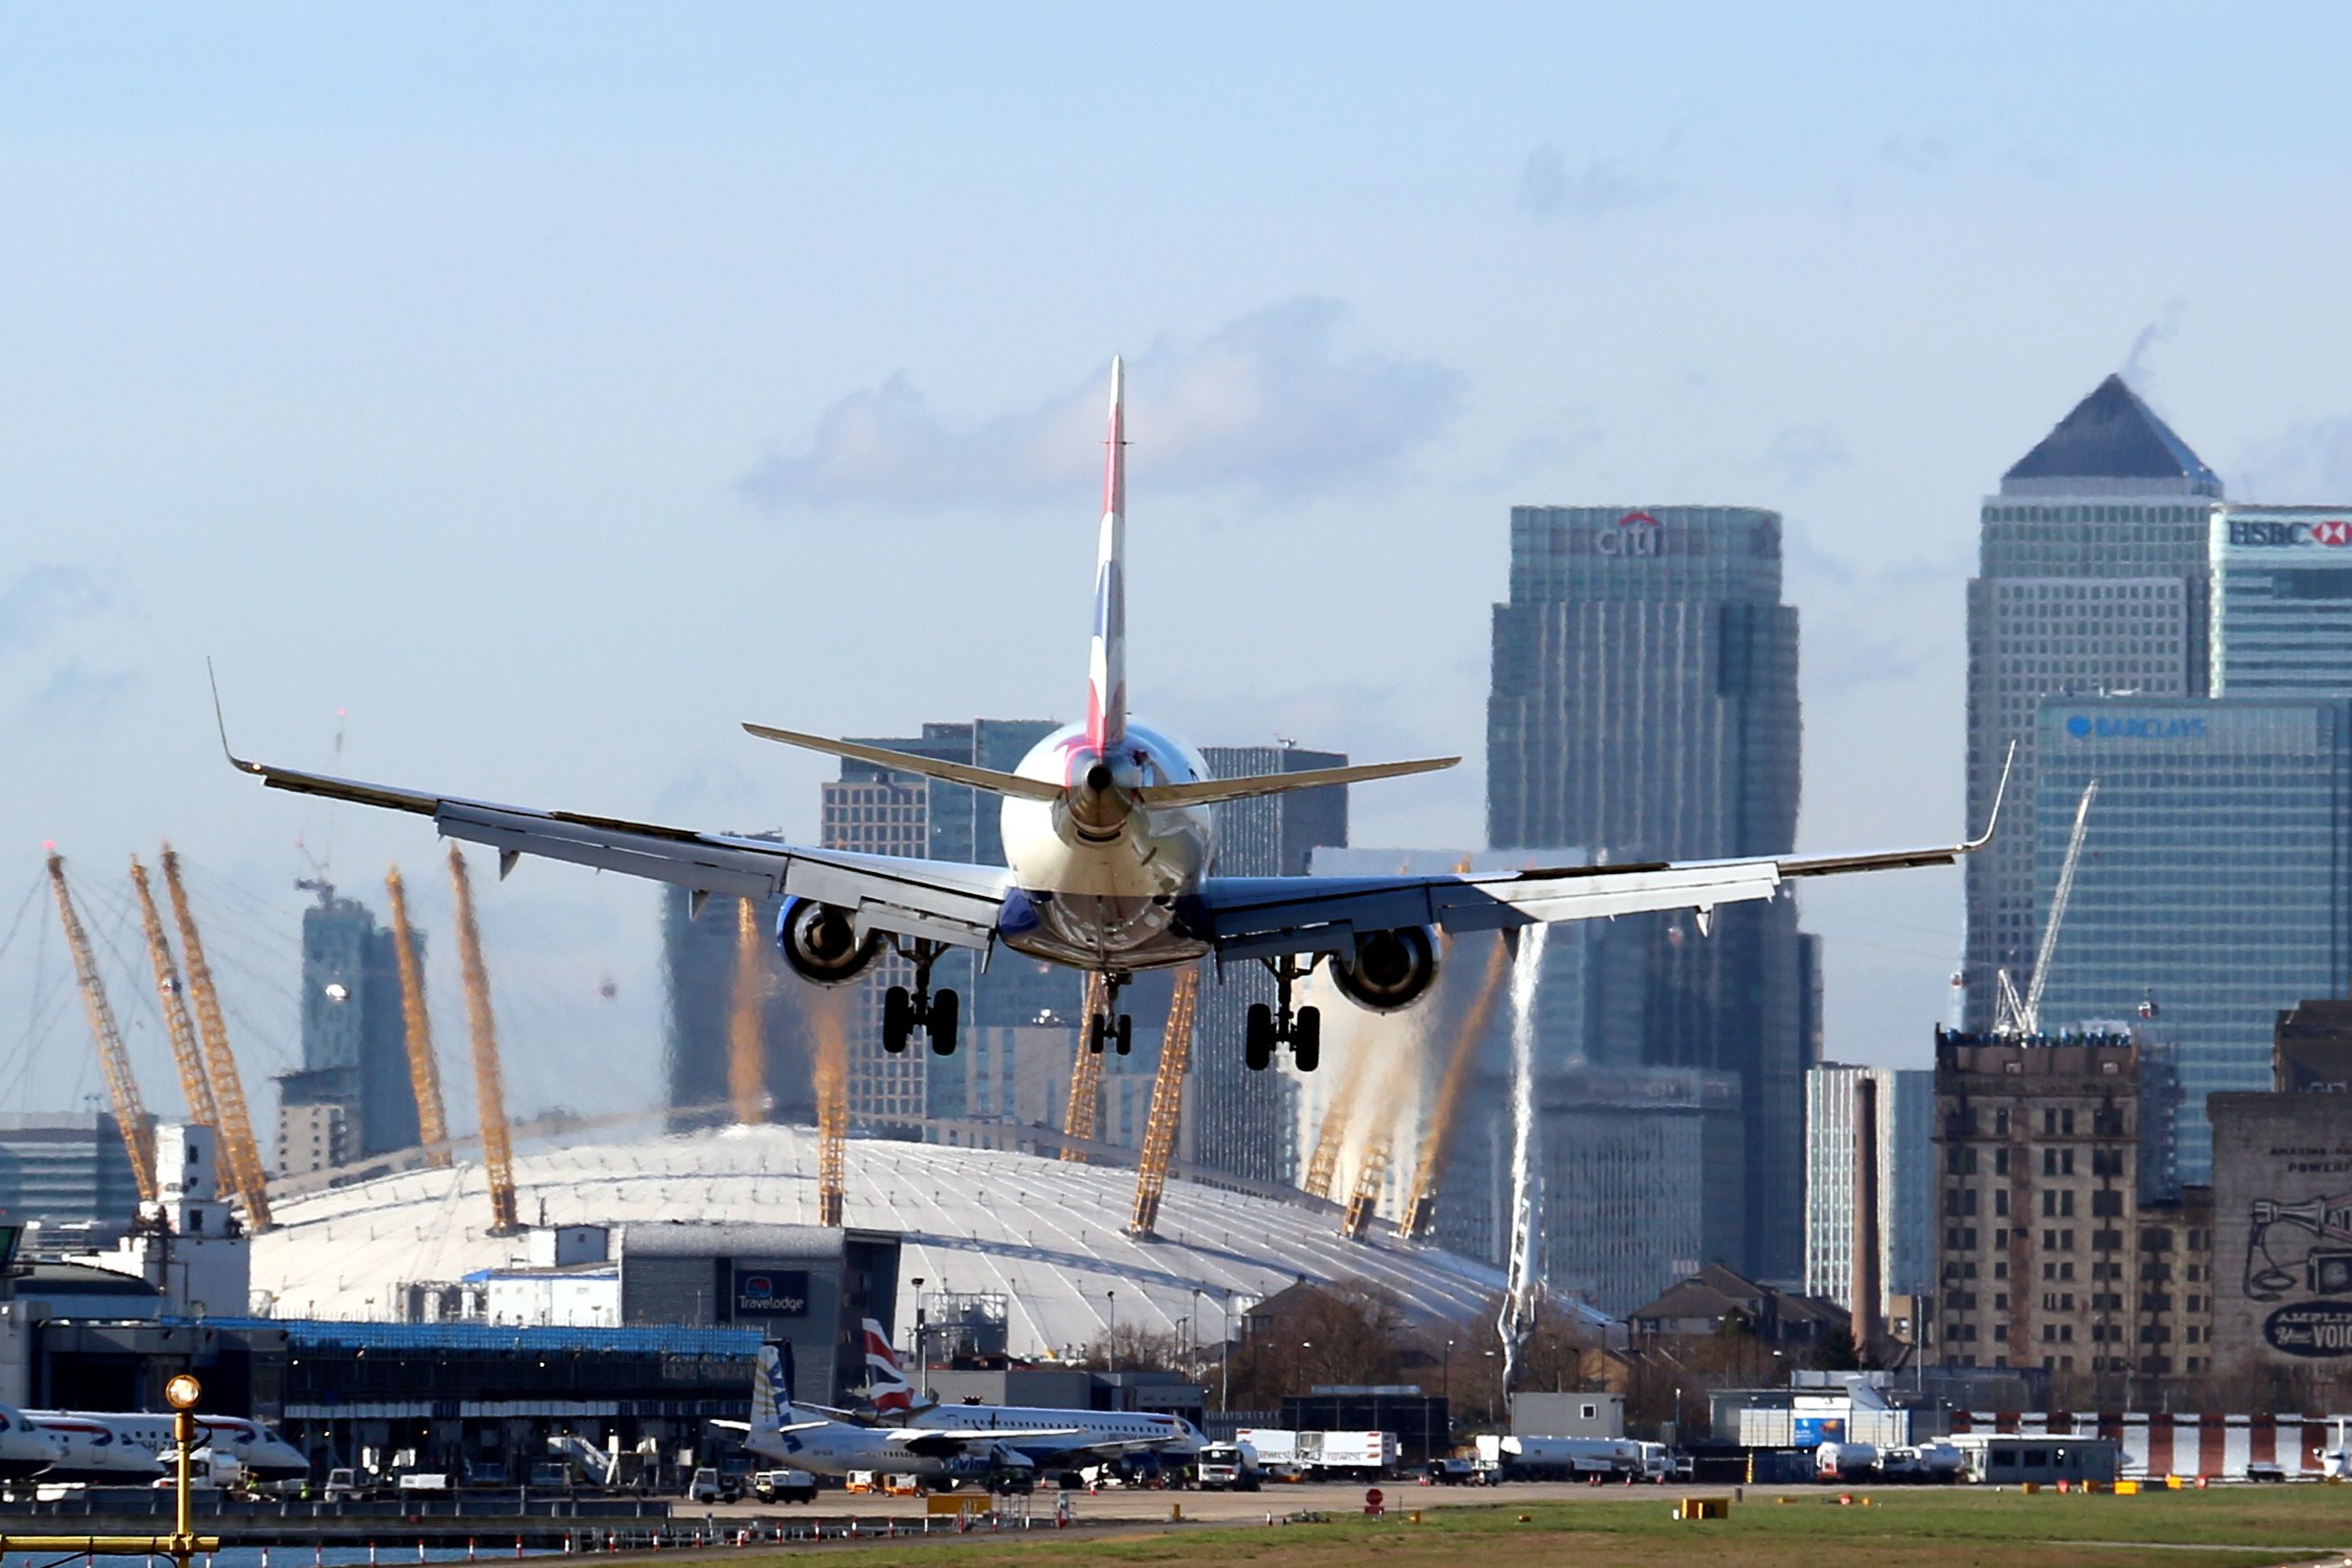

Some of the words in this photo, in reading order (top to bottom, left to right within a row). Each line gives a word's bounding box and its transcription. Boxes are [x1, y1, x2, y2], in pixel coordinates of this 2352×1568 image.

[1596, 524, 1655, 555] citi
[2229, 521, 2313, 545] HSBC
[2096, 717, 2206, 737] BARCLAYS
[738, 1295, 804, 1312] Travelodge
